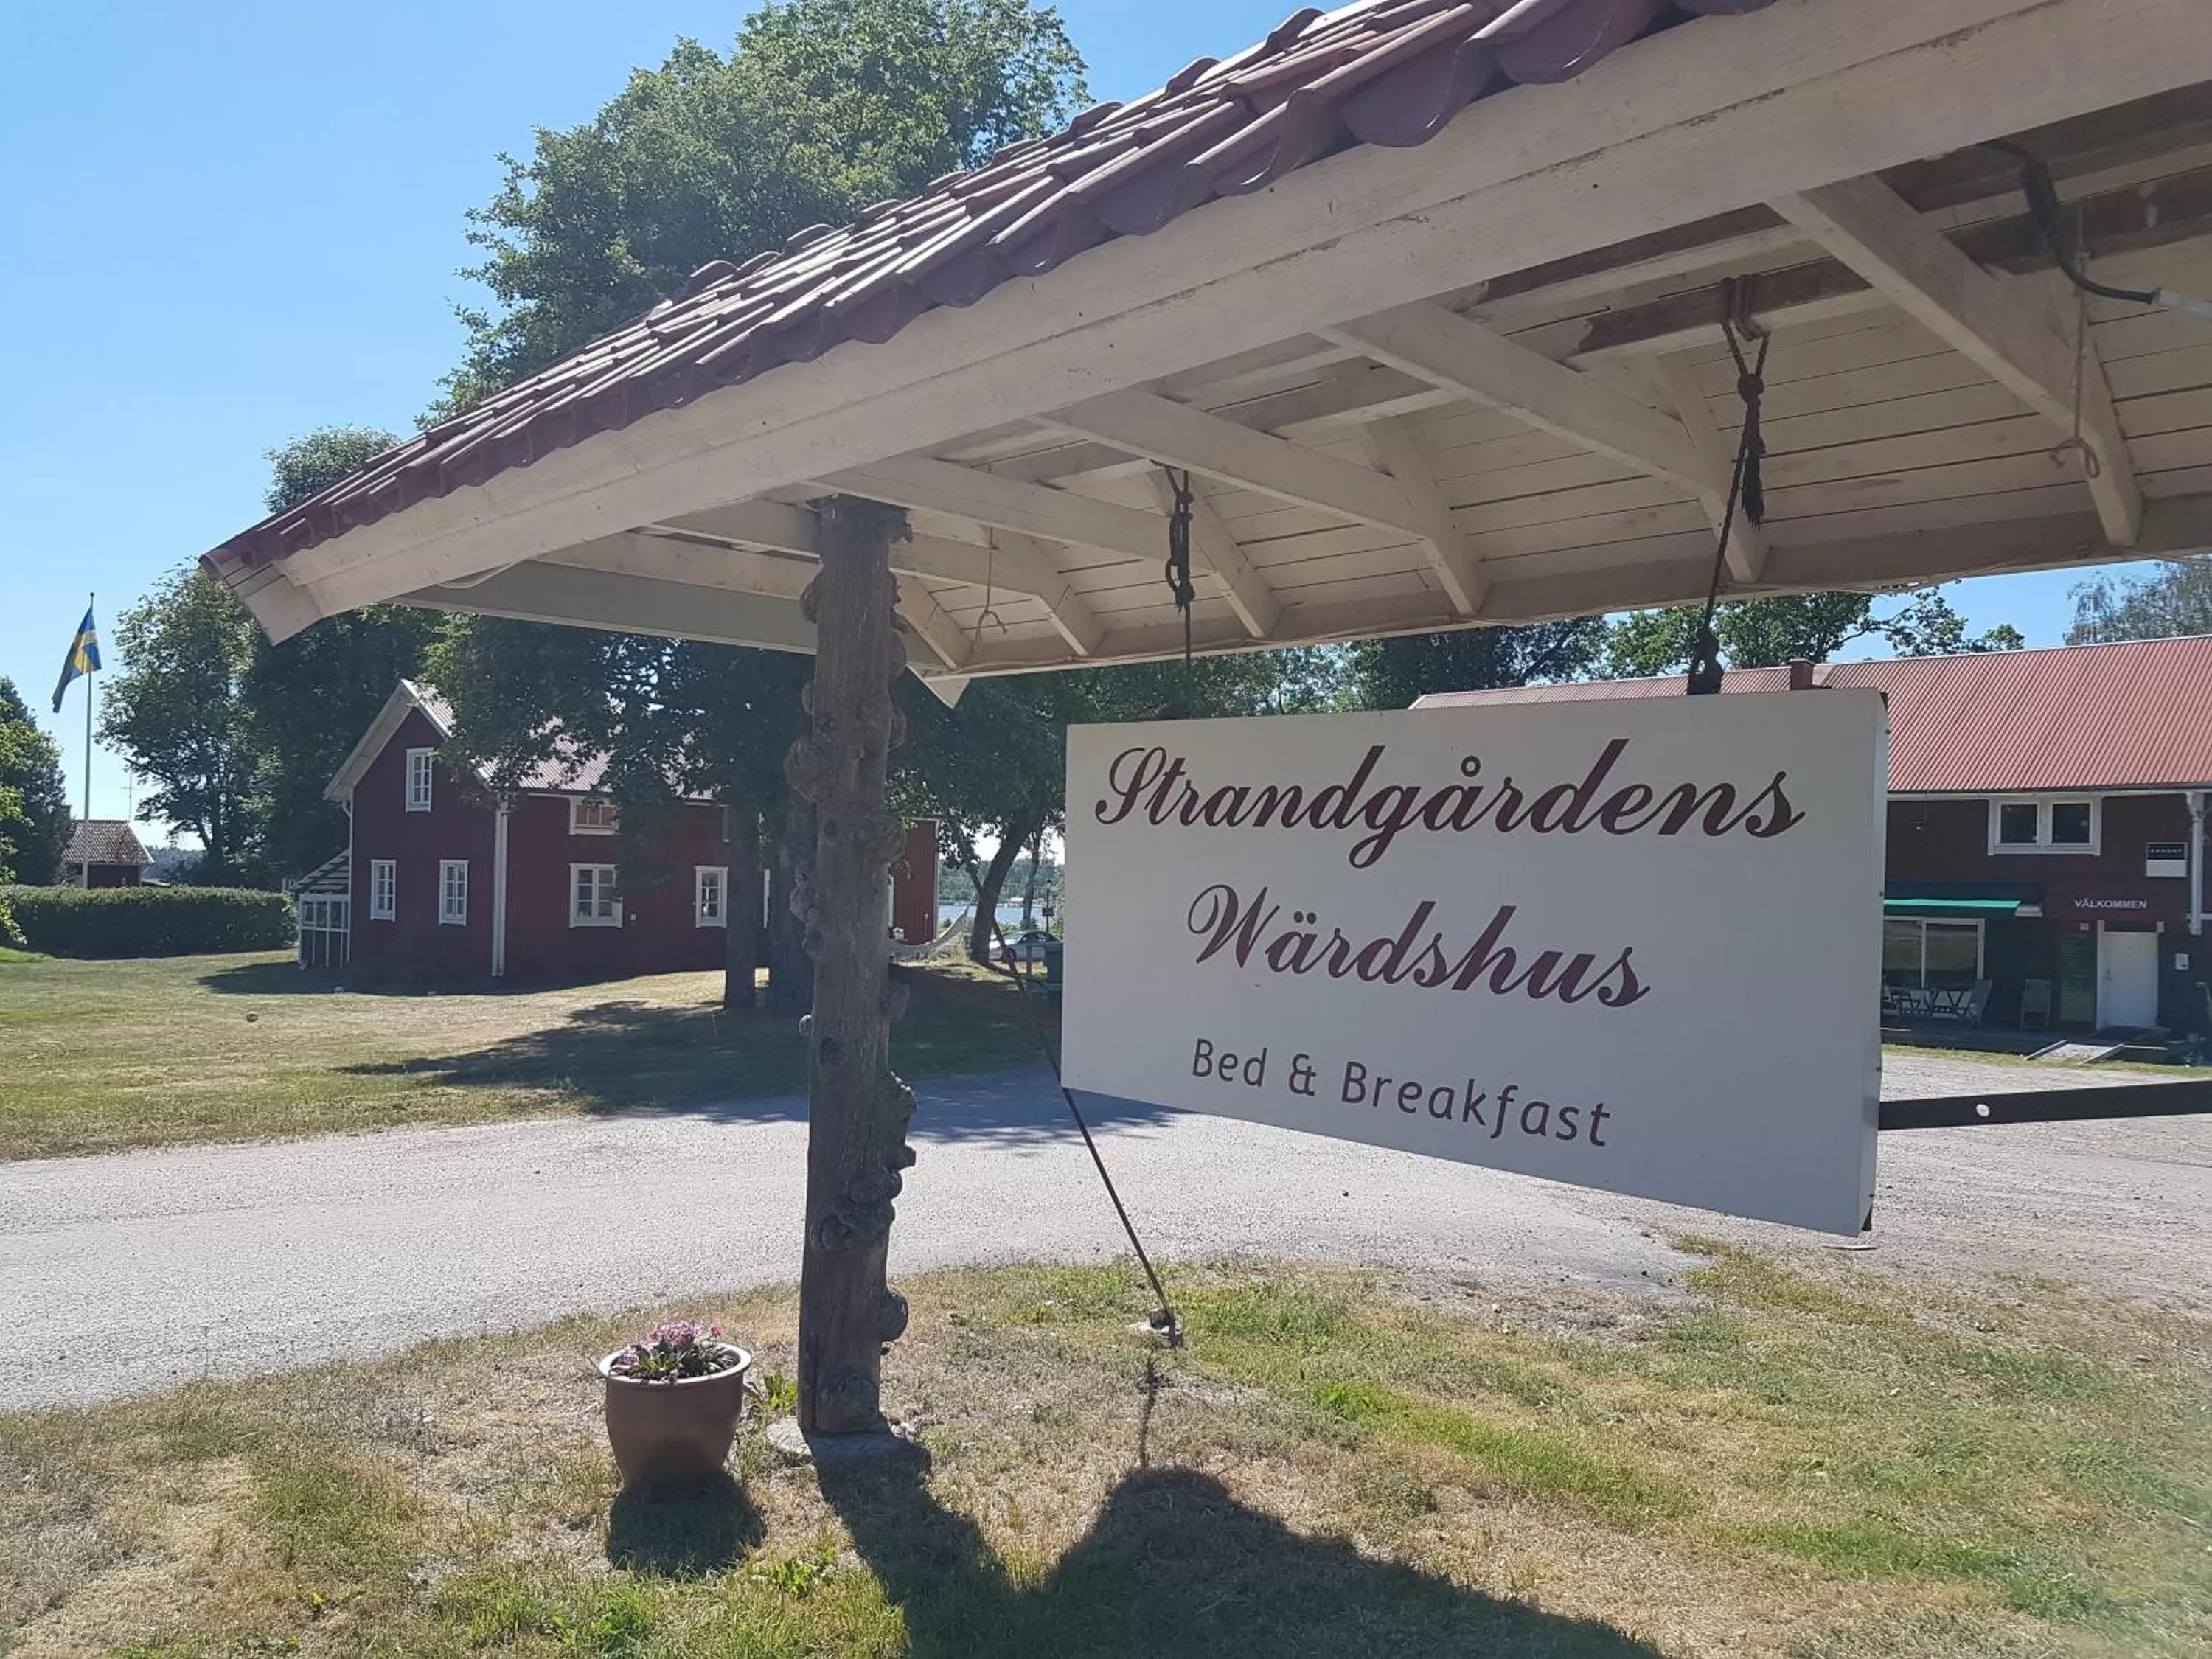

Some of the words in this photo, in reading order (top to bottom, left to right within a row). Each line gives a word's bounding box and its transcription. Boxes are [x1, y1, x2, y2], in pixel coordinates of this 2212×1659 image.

[1095, 739, 1806, 869] Strandgårdens
[1187, 884, 1652, 1009] Wärdshus
[2073, 897, 2147, 908] VÄLKOMMEN
[1192, 1037, 1268, 1088] Bed
[1288, 1054, 1318, 1096] &
[1341, 1061, 1613, 1147] Breakfast
